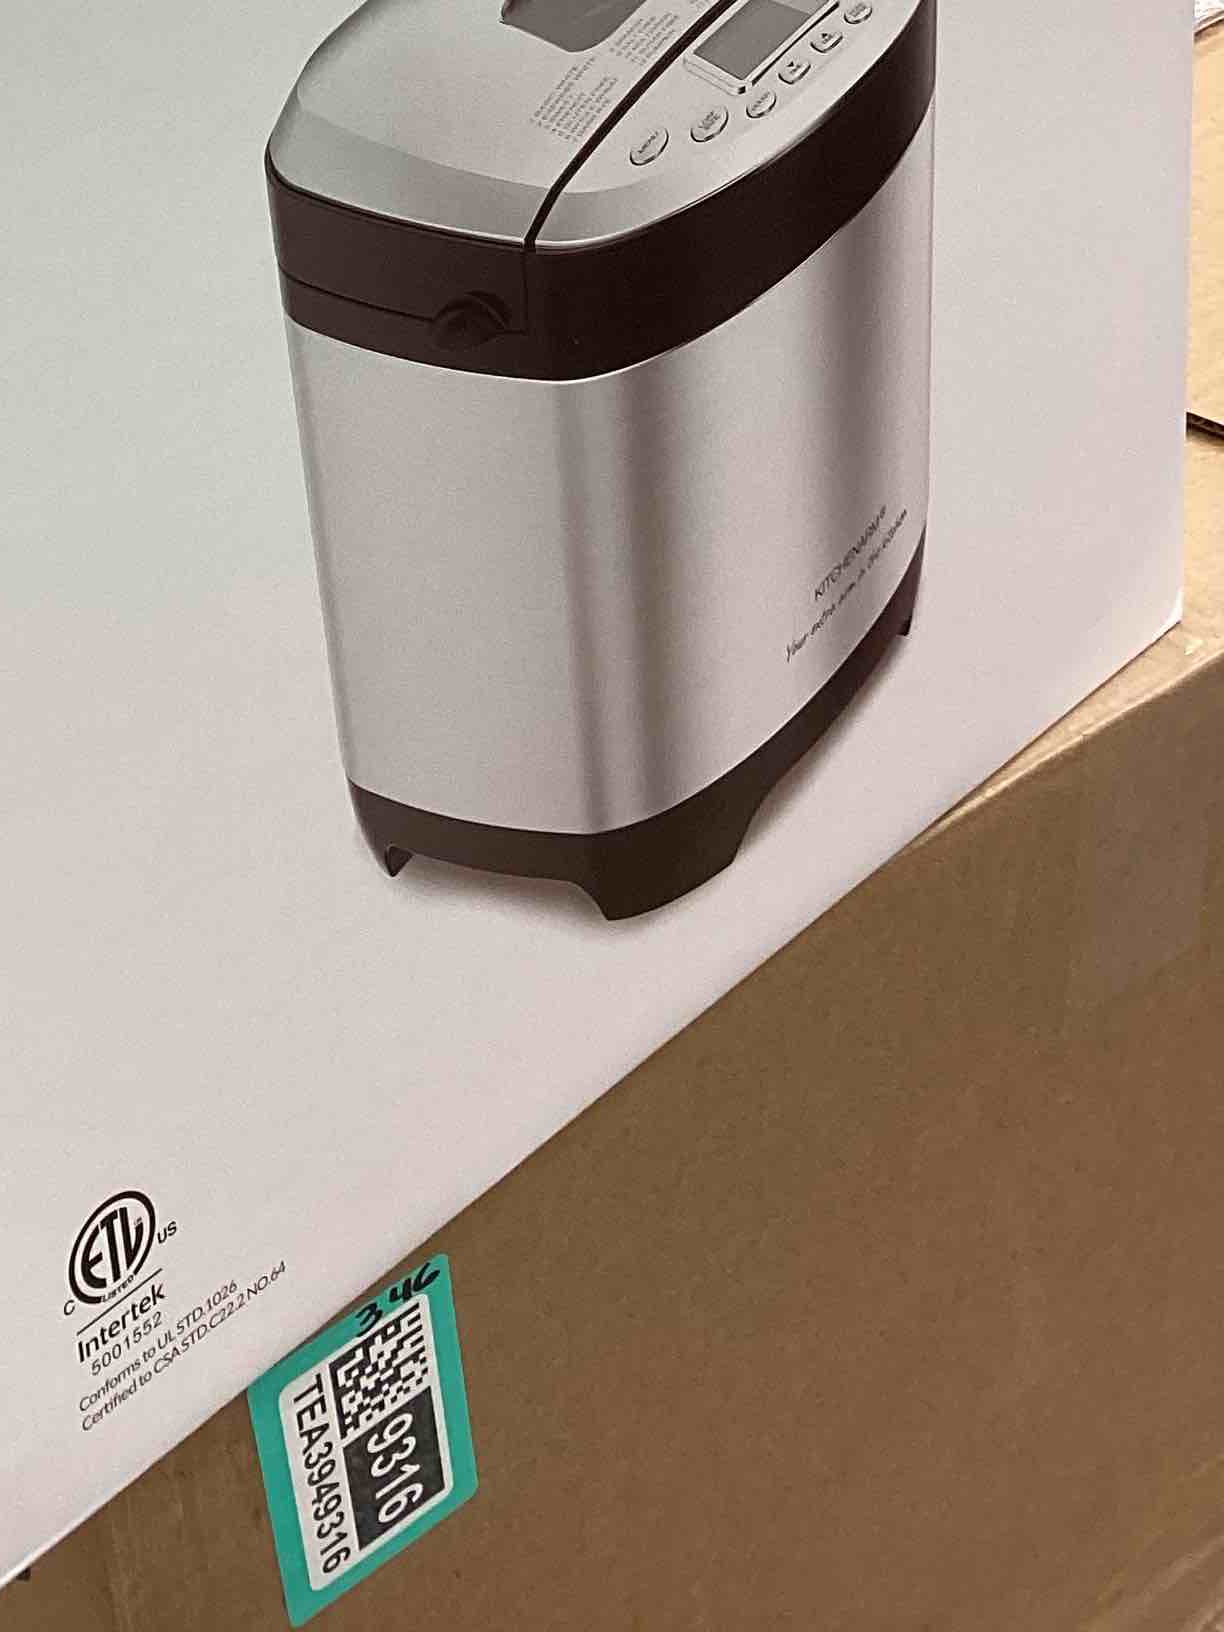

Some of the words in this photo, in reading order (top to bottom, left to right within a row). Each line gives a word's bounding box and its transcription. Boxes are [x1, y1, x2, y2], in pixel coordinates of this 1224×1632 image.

[77, 1283, 166, 1363] Intertek
[91, 1311, 163, 1376] 5001552
[79, 1358, 141, 1413] Conforms
[143, 1348, 156, 1364] to
[157, 1332, 176, 1351] UL
[82, 1381, 138, 1432] Certified
[139, 1369, 153, 1389] to
[293, 1372, 352, 1575] TEA3949316
[366, 1412, 424, 1525] 9316
